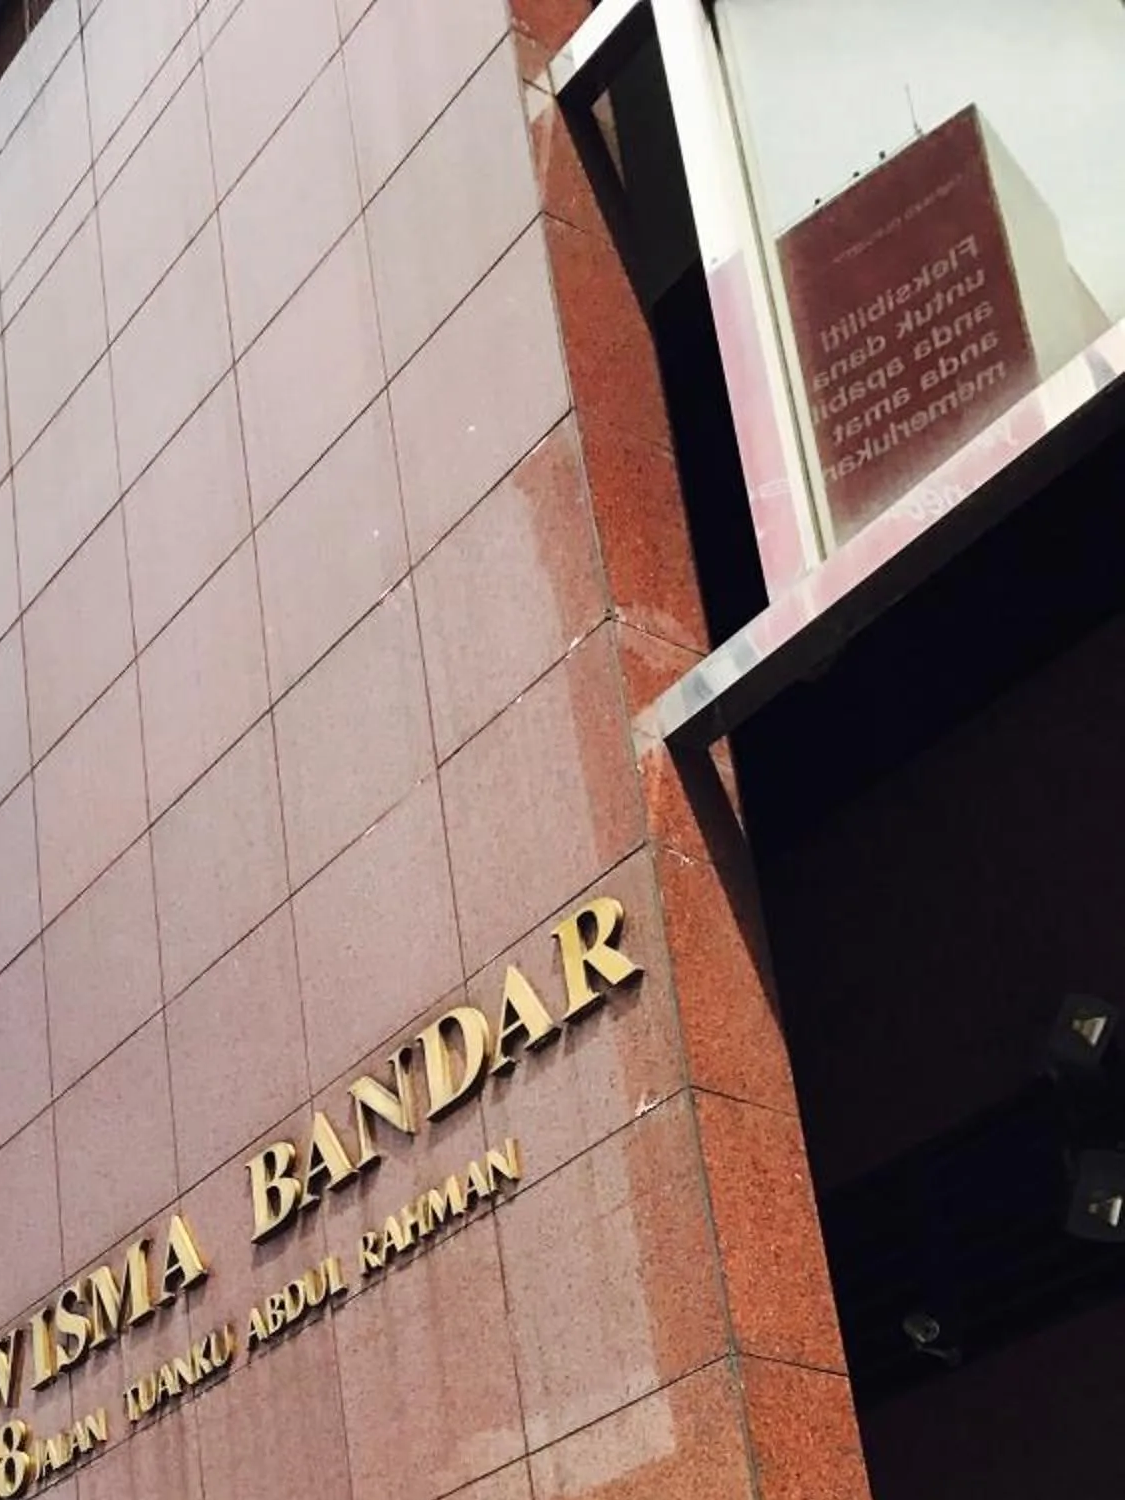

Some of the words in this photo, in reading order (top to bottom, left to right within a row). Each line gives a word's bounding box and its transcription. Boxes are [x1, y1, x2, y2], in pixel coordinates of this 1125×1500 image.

[244, 896, 644, 1244] BANDAR
[122, 1323, 237, 1424] TUANKU
[248, 1255, 349, 1348] ABDUL
[360, 1138, 521, 1276] RAHMAN
